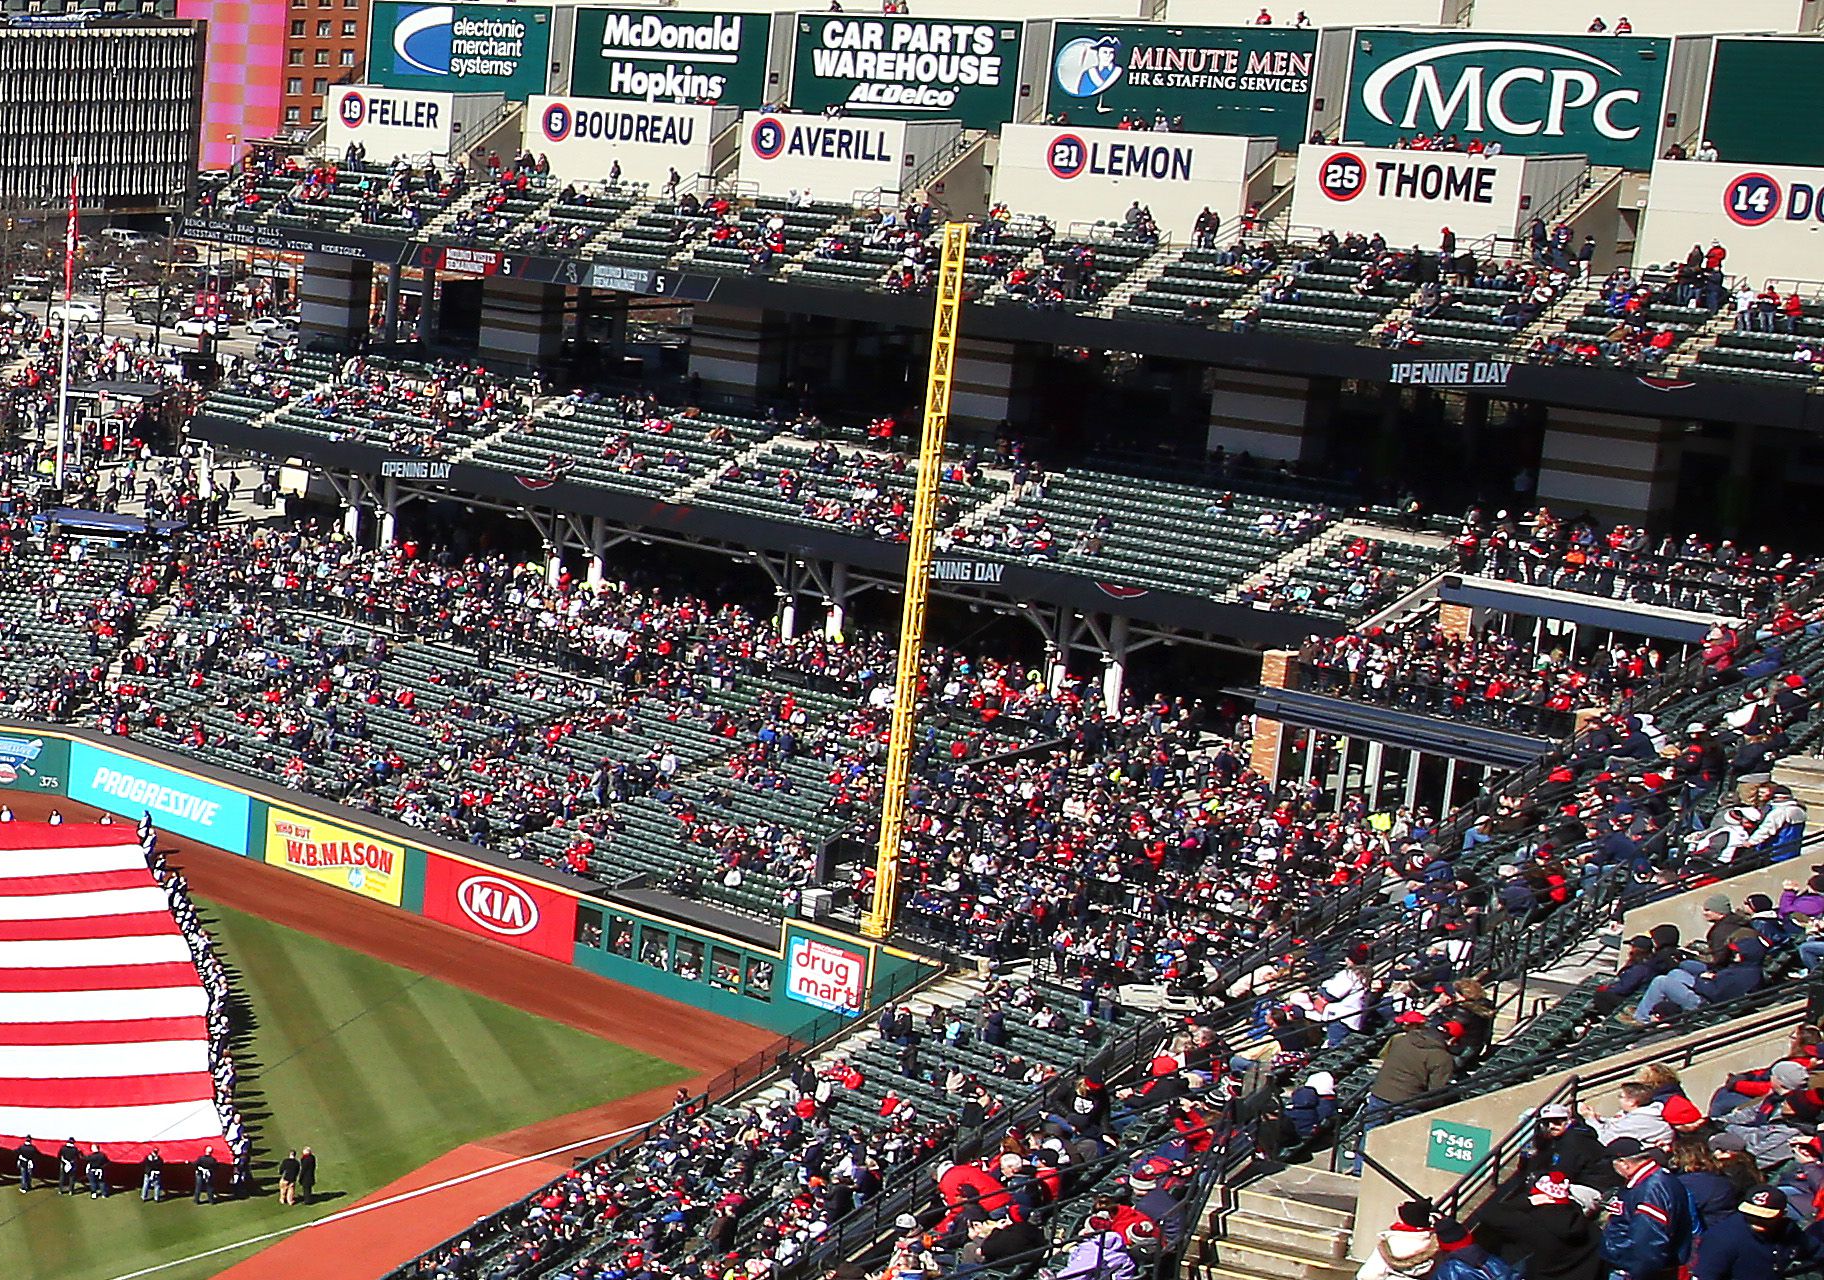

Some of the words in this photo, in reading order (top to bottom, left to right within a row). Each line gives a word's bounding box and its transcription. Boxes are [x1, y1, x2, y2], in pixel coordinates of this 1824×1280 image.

[452, 18, 525, 39] electronic
[604, 14, 741, 52] McDonald
[823, 21, 884, 51] CAR
[893, 23, 995, 54] PARTS
[452, 37, 523, 58] merchant
[450, 56, 516, 77] systems
[813, 49, 1000, 86] WAREHOUSE
[1128, 46, 1241, 73] MINUTE
[1246, 51, 1312, 77] MEN
[611, 62, 724, 104] Hopkins
[849, 82, 956, 108] ACDelco
[1128, 71, 1150, 87] HR
[1152, 73, 1164, 88] &
[1167, 73, 1236, 91] STAFFING
[1239, 76, 1308, 94] SERVICES
[344, 99, 361, 120] 19
[368, 99, 438, 129] FELLER
[1400, 65, 1641, 140] MCPc
[550, 109, 563, 133] 5
[574, 110, 694, 146] BOUDREAU
[760, 126, 776, 150] 3
[788, 126, 891, 162] AVERILL
[1052, 146, 1079, 168] 21
[1090, 146, 1193, 181] LEMON
[1326, 165, 1360, 189] 25
[1374, 162, 1497, 204] THOME
[1733, 185, 1769, 212] 14
[286, 240, 313, 250] VICTOR
[473, 251, 496, 265] VISITS
[503, 257, 511, 275] 5
[656, 275, 665, 293] 5
[1473, 363, 1512, 384] DAY
[382, 461, 428, 478] OPENING
[430, 463, 451, 480] DAY
[929, 561, 971, 580] ENING
[973, 563, 1005, 582] DAY
[39, 775, 58, 789] 375
[92, 768, 220, 827] PROGRESSIVE
[295, 826, 311, 839] BUT
[286, 839, 394, 874] W.B.MASON
[471, 888, 526, 926] KIA
[796, 940, 849, 986] drug
[799, 977, 861, 1009] mart
[1445, 1146, 1472, 1161] 548
[1446, 1134, 1473, 1149] 546
